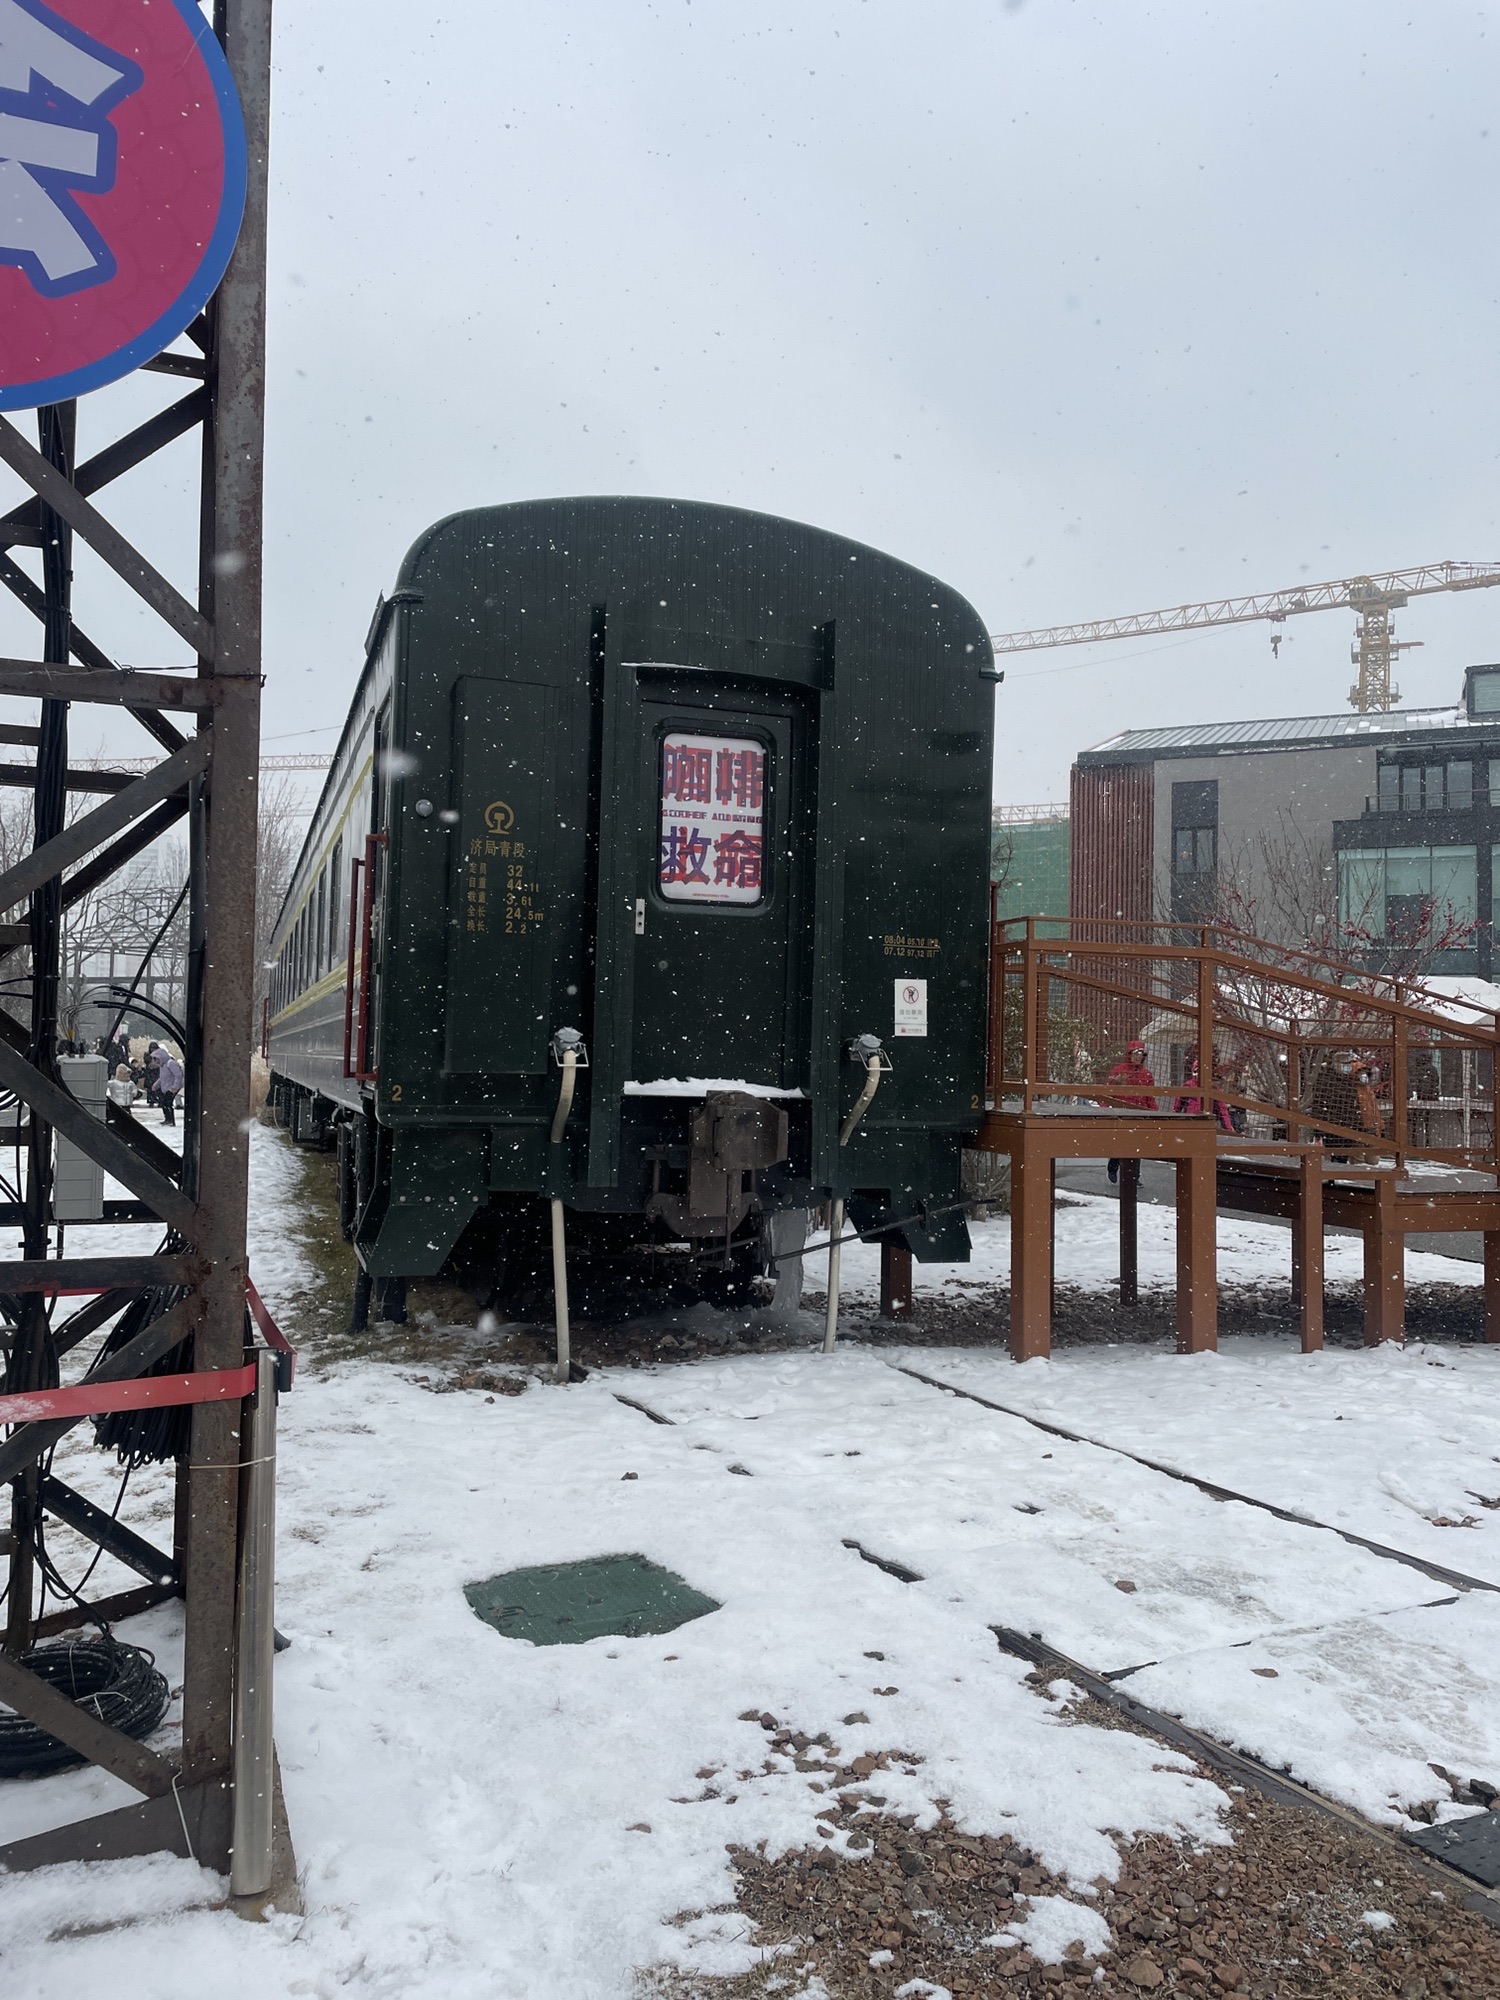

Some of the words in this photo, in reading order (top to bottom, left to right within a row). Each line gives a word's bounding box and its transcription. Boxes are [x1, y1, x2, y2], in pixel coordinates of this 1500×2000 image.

[470, 838, 525, 858] 济局青段
[661, 826, 762, 888] 救命
[507, 864, 524, 877] 32
[467, 904, 486, 917] 全长
[505, 906, 544, 921] 24.5m
[505, 921, 527, 934] 2.2
[883, 946, 906, 957] 07.12
[391, 1084, 402, 1101] 2
[970, 1094, 979, 1109] 2
